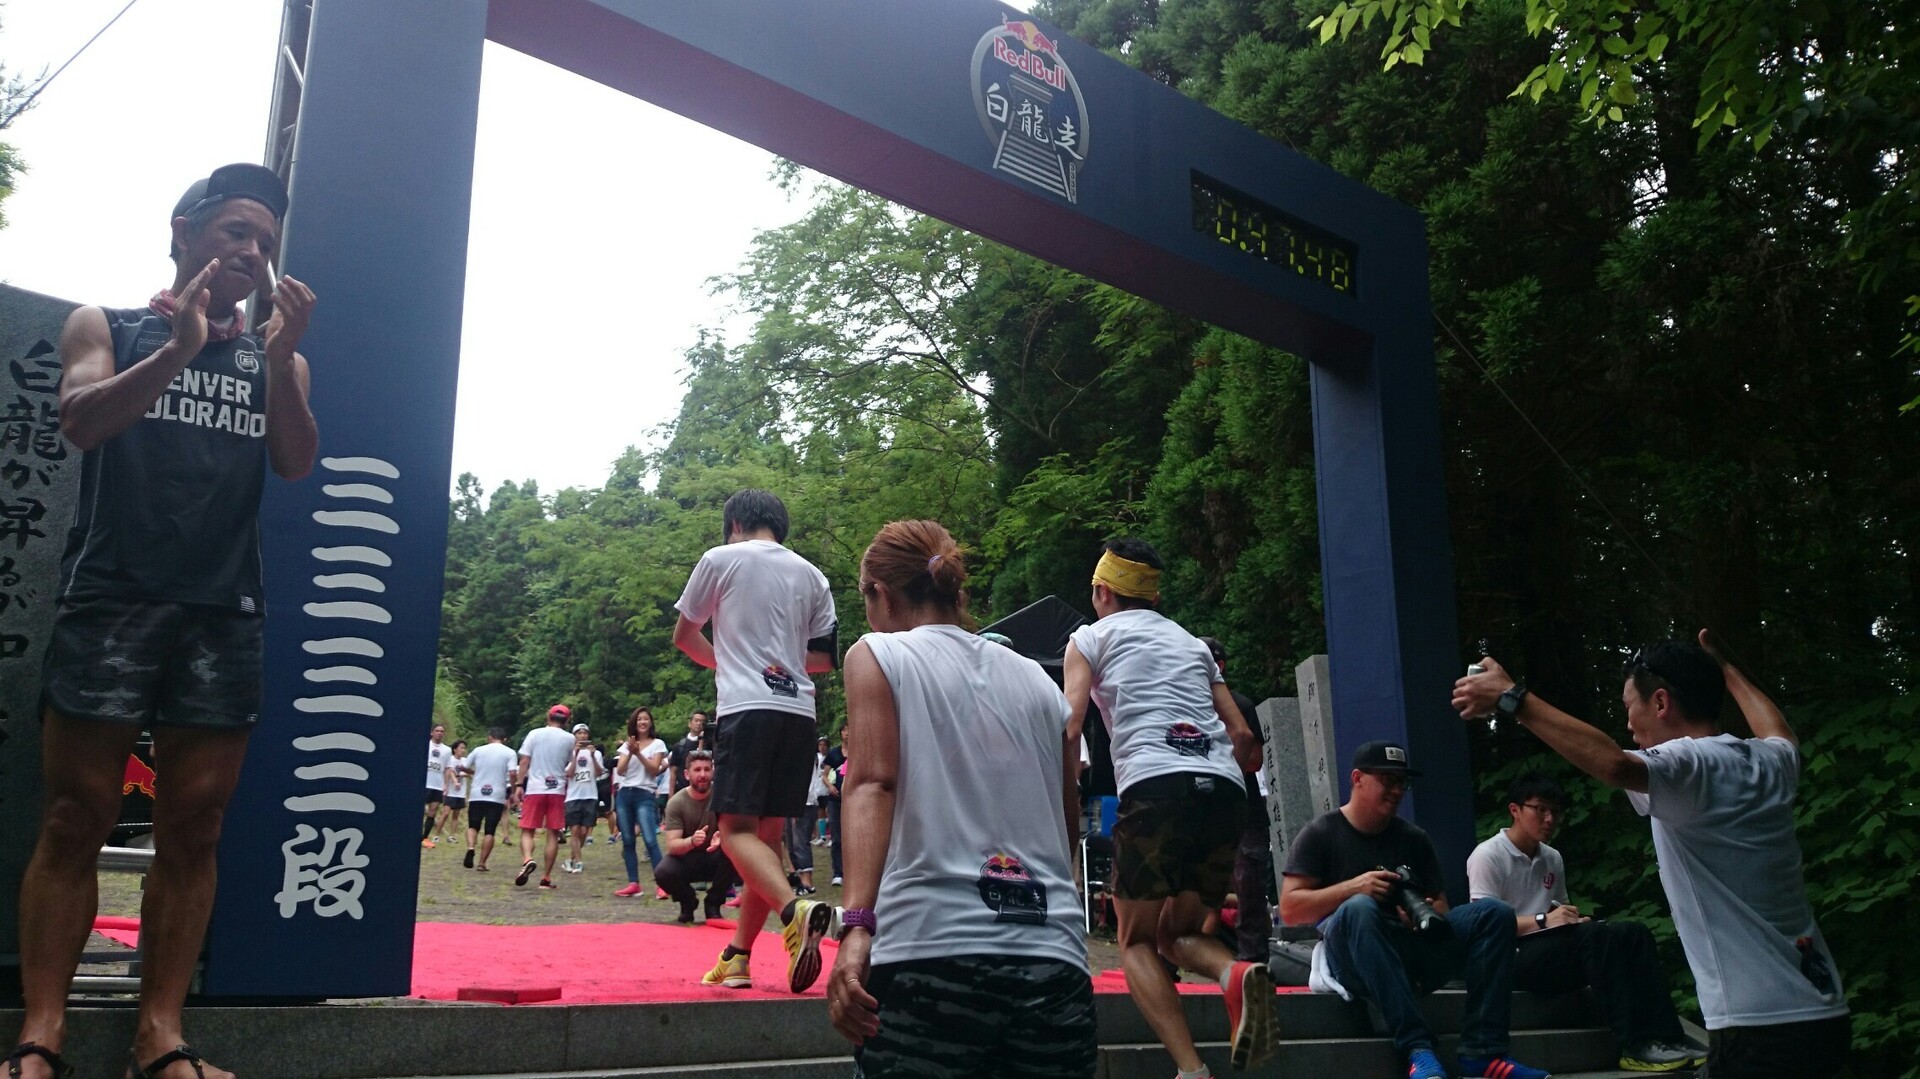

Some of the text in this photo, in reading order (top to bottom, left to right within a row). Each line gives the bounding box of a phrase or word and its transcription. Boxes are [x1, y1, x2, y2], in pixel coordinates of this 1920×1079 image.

[986, 82, 1084, 161] 白龍走
[166, 367, 252, 406] ENVER
[143, 393, 266, 438] OLORADO
